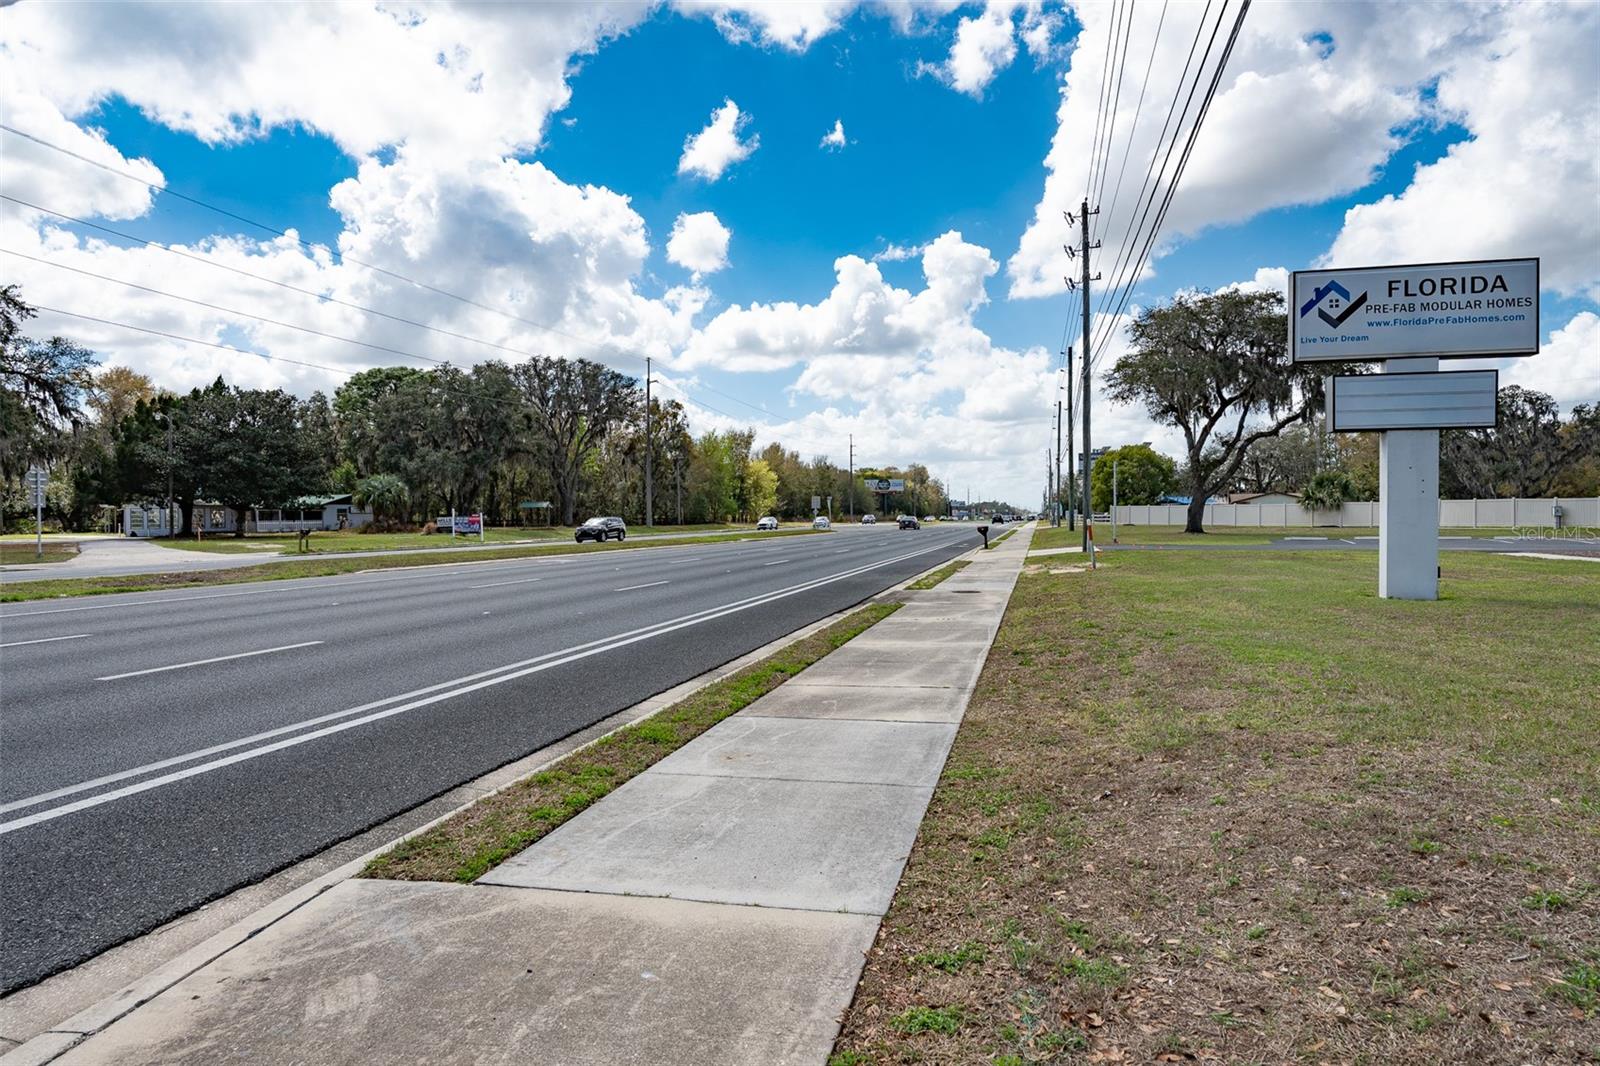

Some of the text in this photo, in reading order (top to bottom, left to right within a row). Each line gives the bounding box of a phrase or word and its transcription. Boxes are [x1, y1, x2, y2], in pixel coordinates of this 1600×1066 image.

[1388, 274, 1508, 298] FLORIDA
[1366, 297, 1533, 314] PRE-FAB MODULAR HOMES
[1367, 314, 1525, 328] www.FloridaPreFabHomes.com
[1301, 336, 1317, 344] Live
[1341, 334, 1369, 342] Dream
